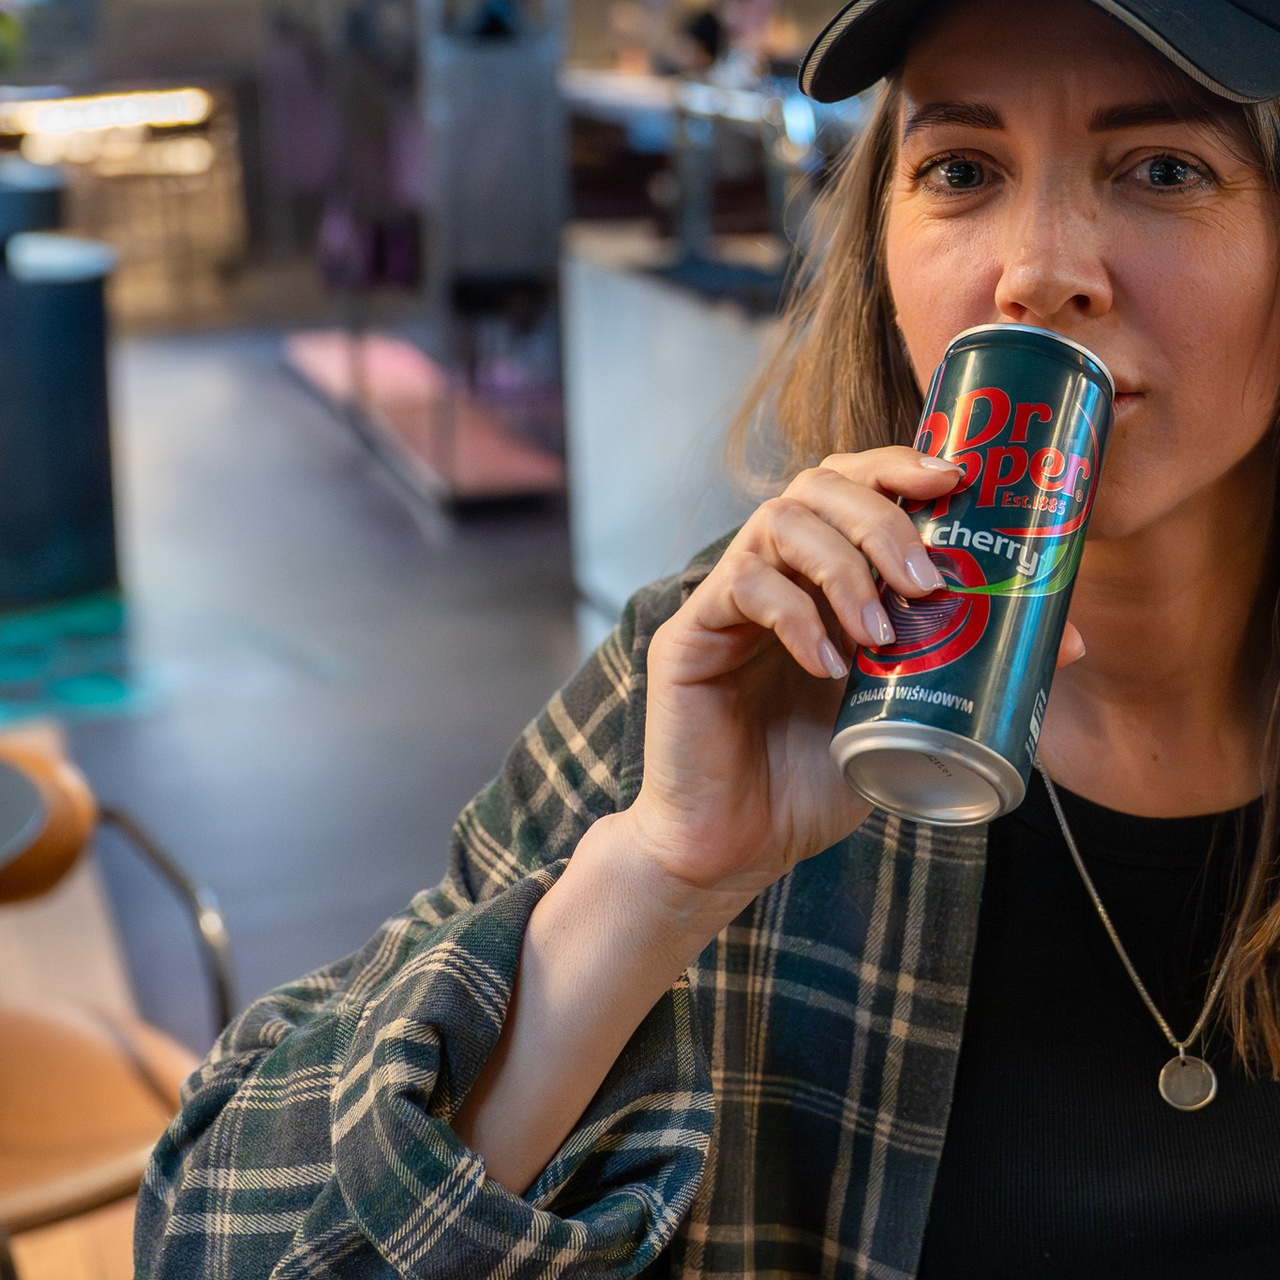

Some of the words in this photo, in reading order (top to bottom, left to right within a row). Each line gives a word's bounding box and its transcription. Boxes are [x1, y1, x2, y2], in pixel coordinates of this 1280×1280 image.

[944, 386, 1053, 460] Dr
[908, 411, 1091, 521] pper
[932, 520, 1039, 576] cherry
[895, 684, 974, 714] WIŚNIOWYM
